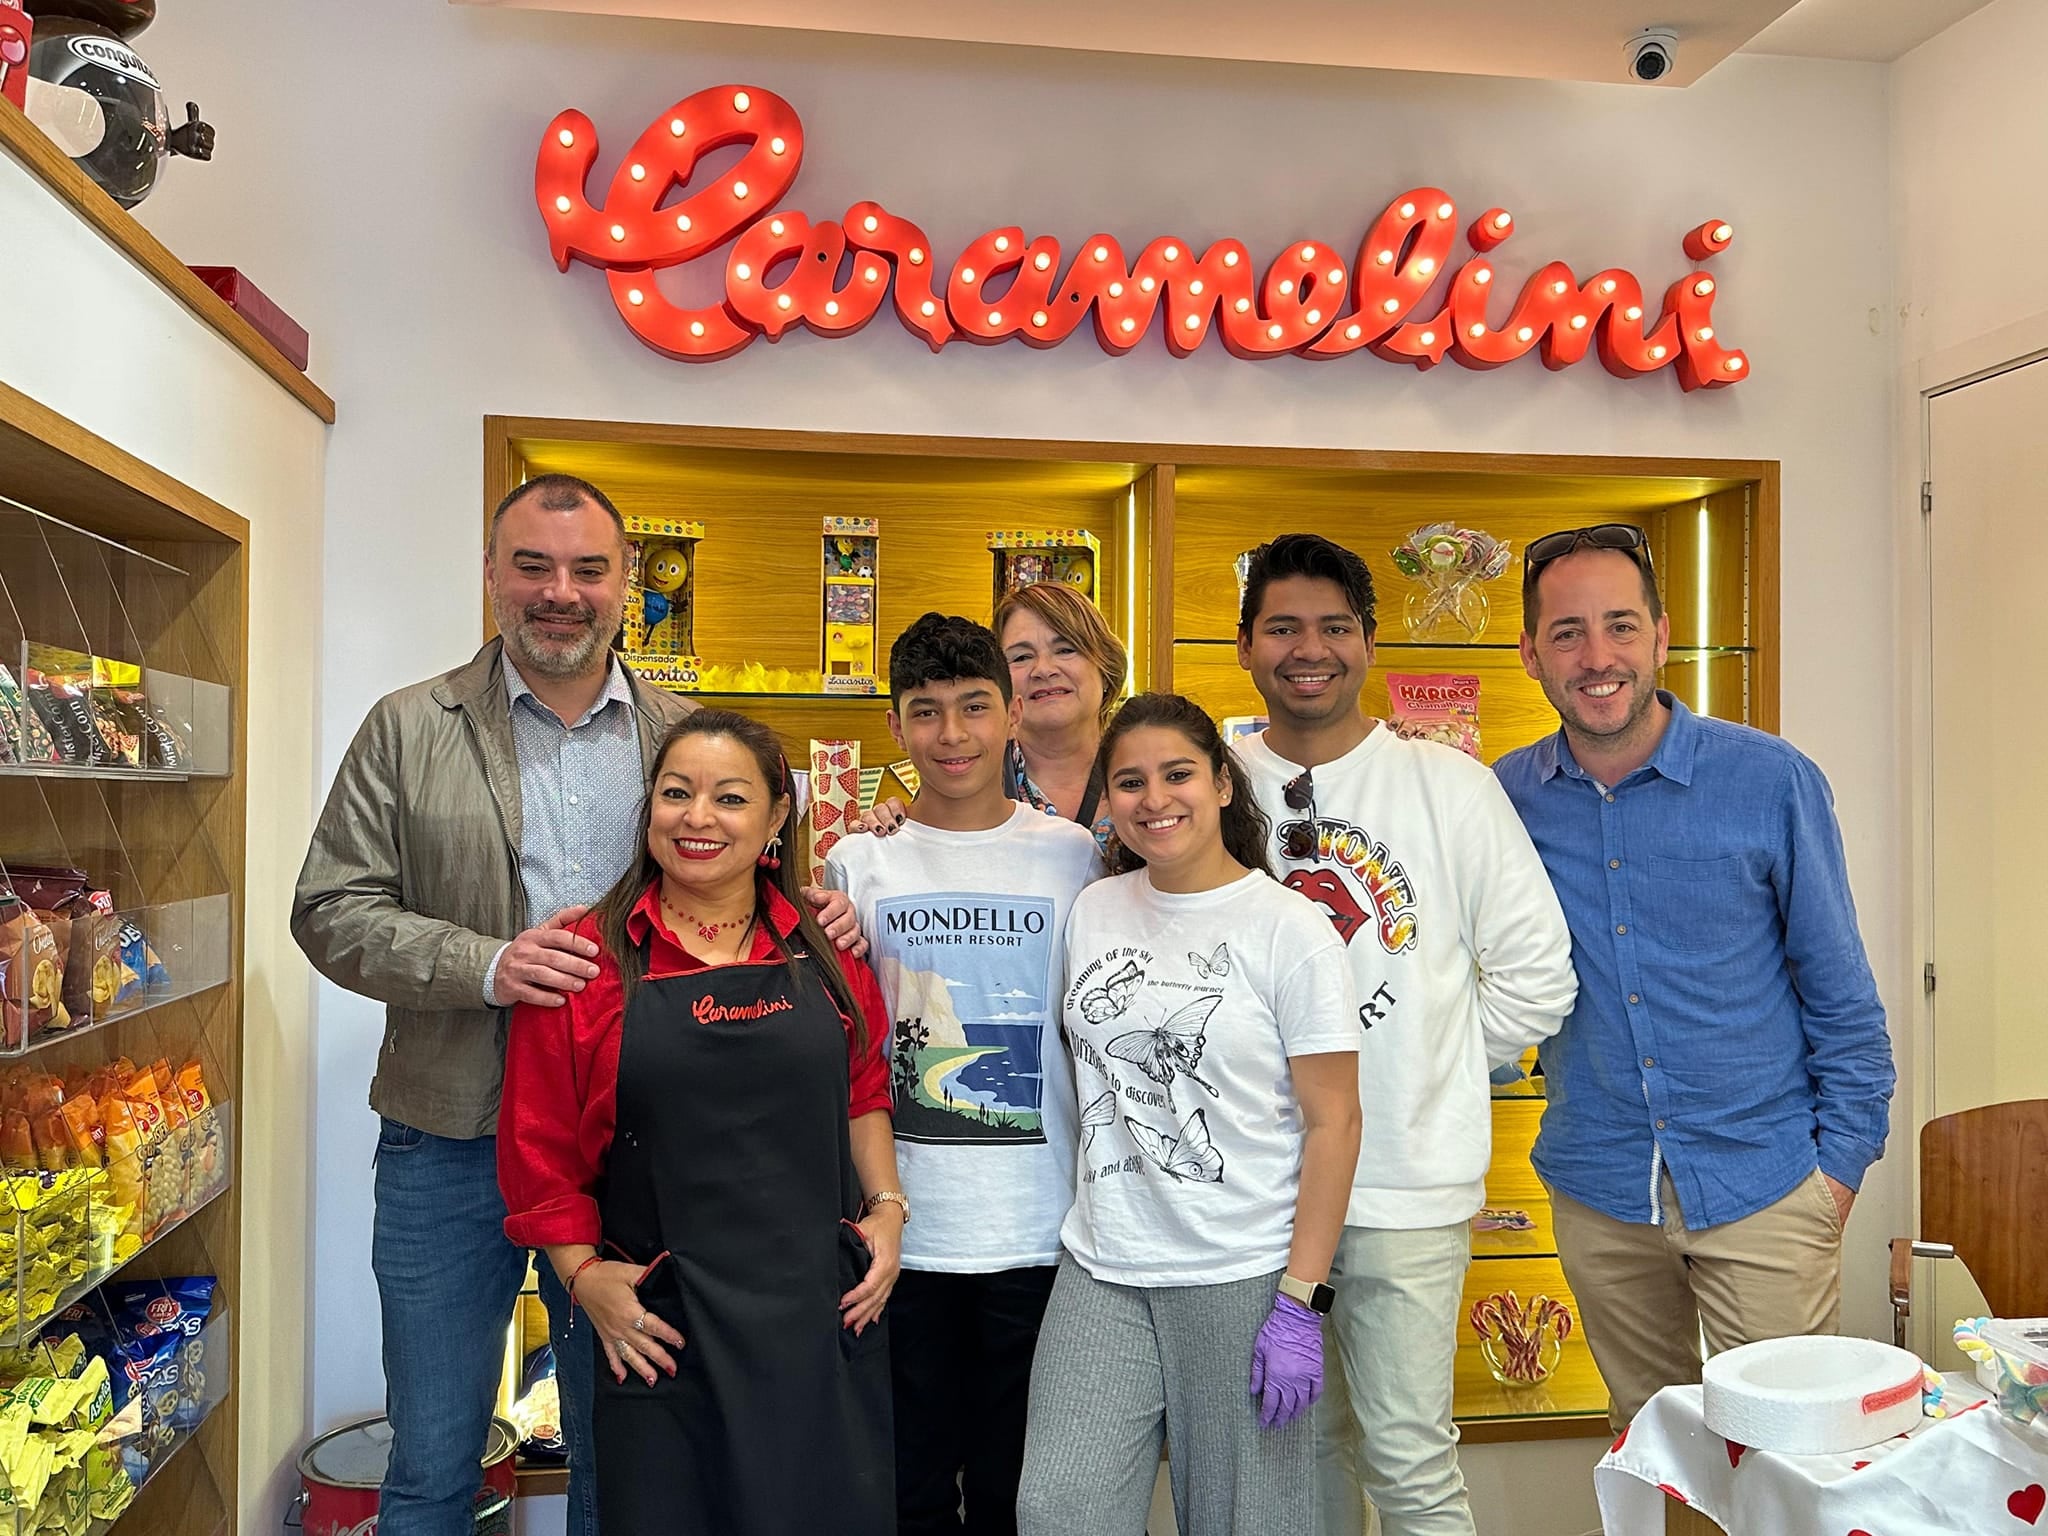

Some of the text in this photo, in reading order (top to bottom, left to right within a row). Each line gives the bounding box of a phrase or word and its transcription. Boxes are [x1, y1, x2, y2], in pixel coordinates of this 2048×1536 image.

[534, 84, 1750, 391] Caramelini
[623, 653, 678, 664] Dispensador
[633, 665, 698, 682] casitos
[1399, 685, 1476, 701] HARIBO
[887, 907, 1045, 935] MONDELLO
[907, 935, 1023, 947] SUMMER RESORT
[1066, 959, 1103, 1010] dreaming
[1161, 980, 1192, 991] butterfly
[691, 994, 794, 1025] Caramelini
[1360, 980, 1397, 1031] RT
[1111, 1072, 1121, 1092] to
[1100, 1160, 1120, 1178] and
